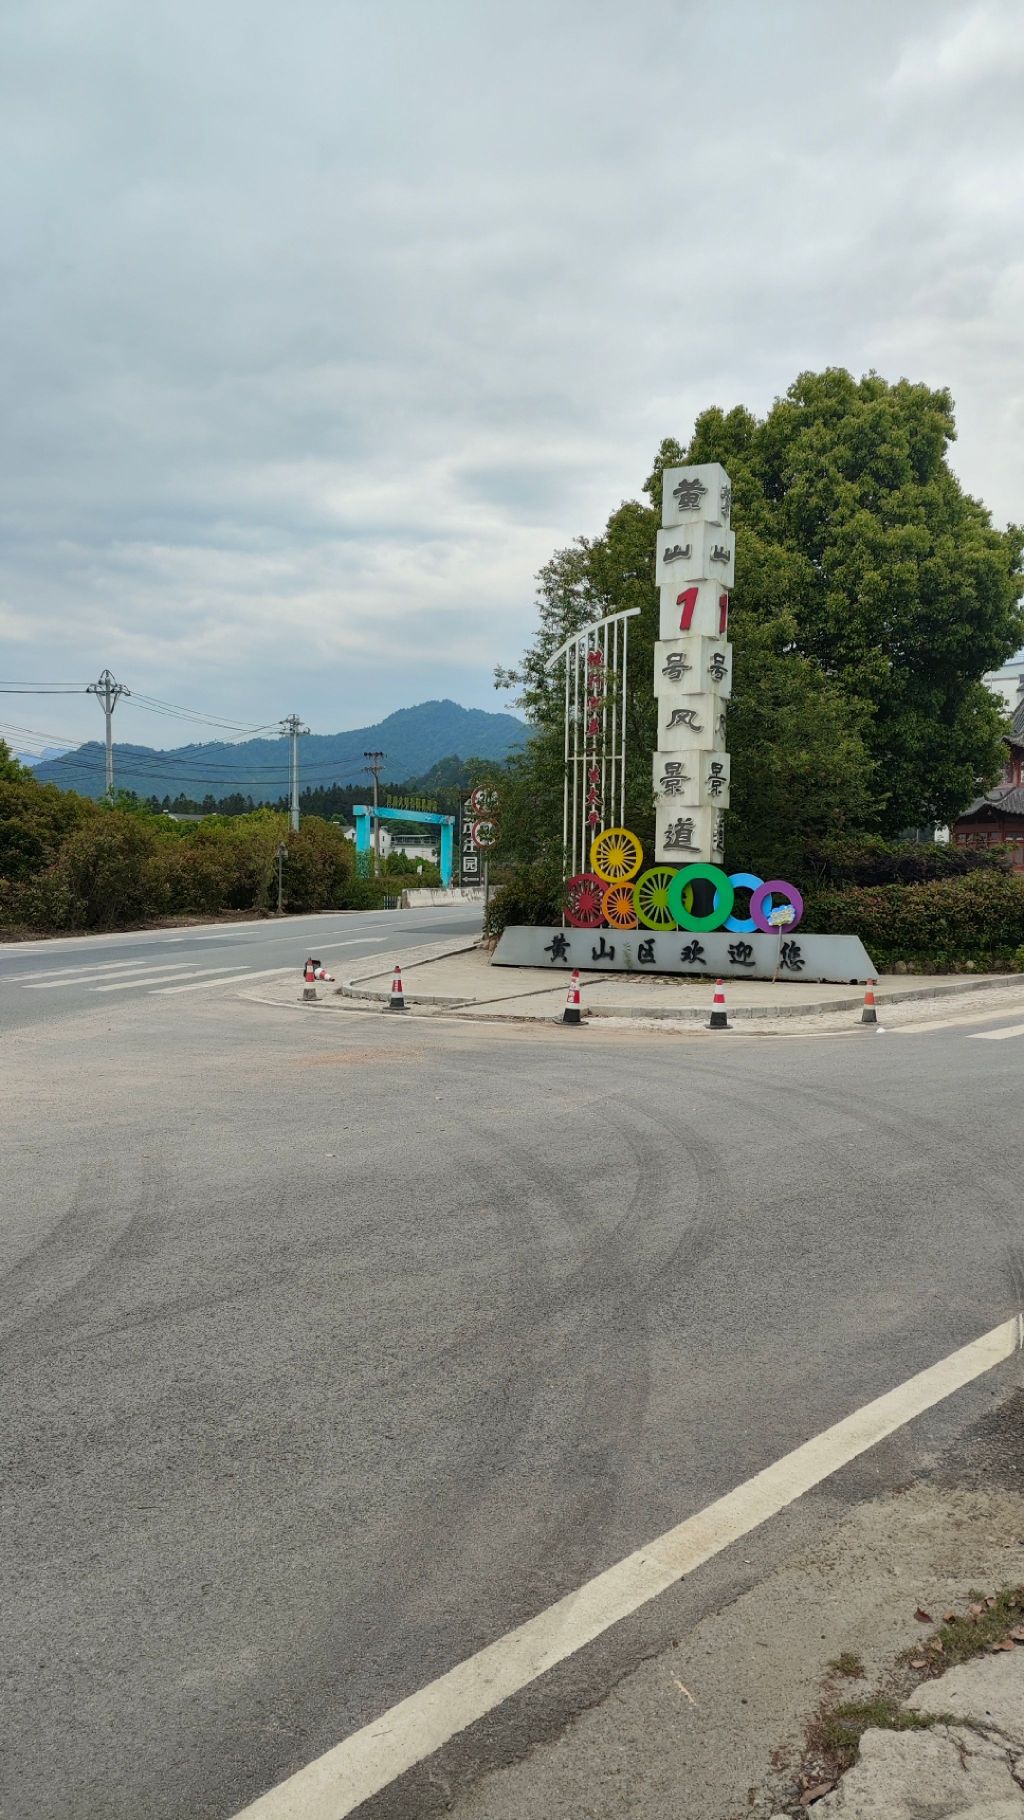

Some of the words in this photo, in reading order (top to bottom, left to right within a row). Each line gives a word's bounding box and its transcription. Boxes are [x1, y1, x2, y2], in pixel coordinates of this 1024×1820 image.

[659, 479, 706, 853] 黄山1号风景道
[544, 933, 806, 971] 黄山区欢迎您
